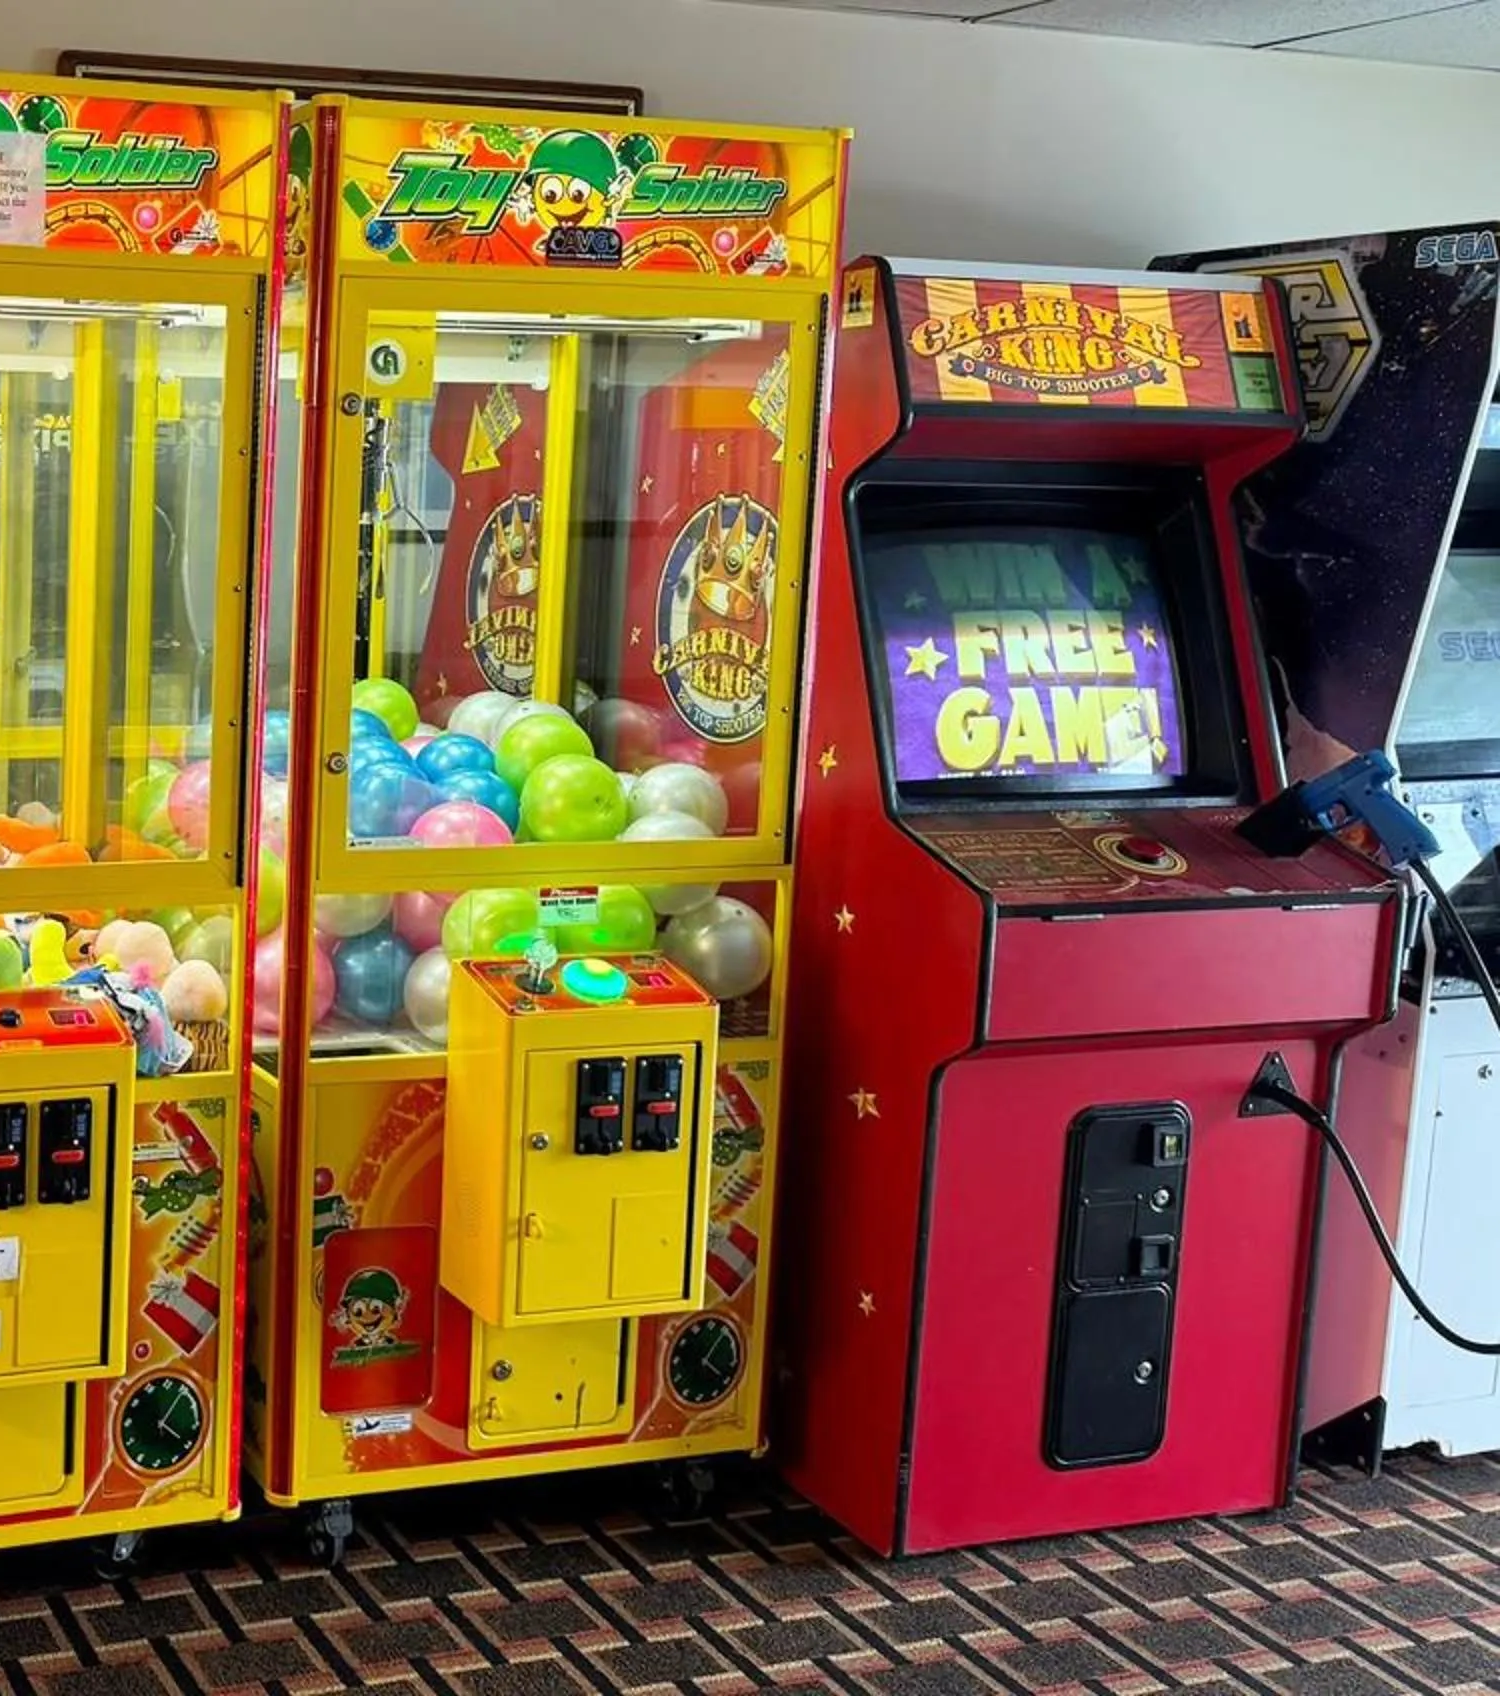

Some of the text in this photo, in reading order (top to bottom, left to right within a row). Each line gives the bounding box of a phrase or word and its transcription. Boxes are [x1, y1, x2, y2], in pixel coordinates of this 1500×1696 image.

[46, 130, 216, 188] Soldier
[9, 184, 29, 194] you
[12, 197, 27, 207] the
[385, 151, 784, 231] Toy Soldier
[1415, 231, 1498, 268] SEGA
[909, 296, 1203, 369] CARNIVAL
[998, 330, 1115, 375] KING
[985, 366, 1132, 393] BIG TOP SHOOTER
[924, 543, 1133, 606] WIN A
[652, 626, 770, 675] CARNIV
[954, 609, 1137, 680] FREE
[1437, 630, 1500, 661] SE
[691, 659, 752, 701] KING
[693, 709, 713, 729] TOP
[935, 686, 1168, 771] GAME!
